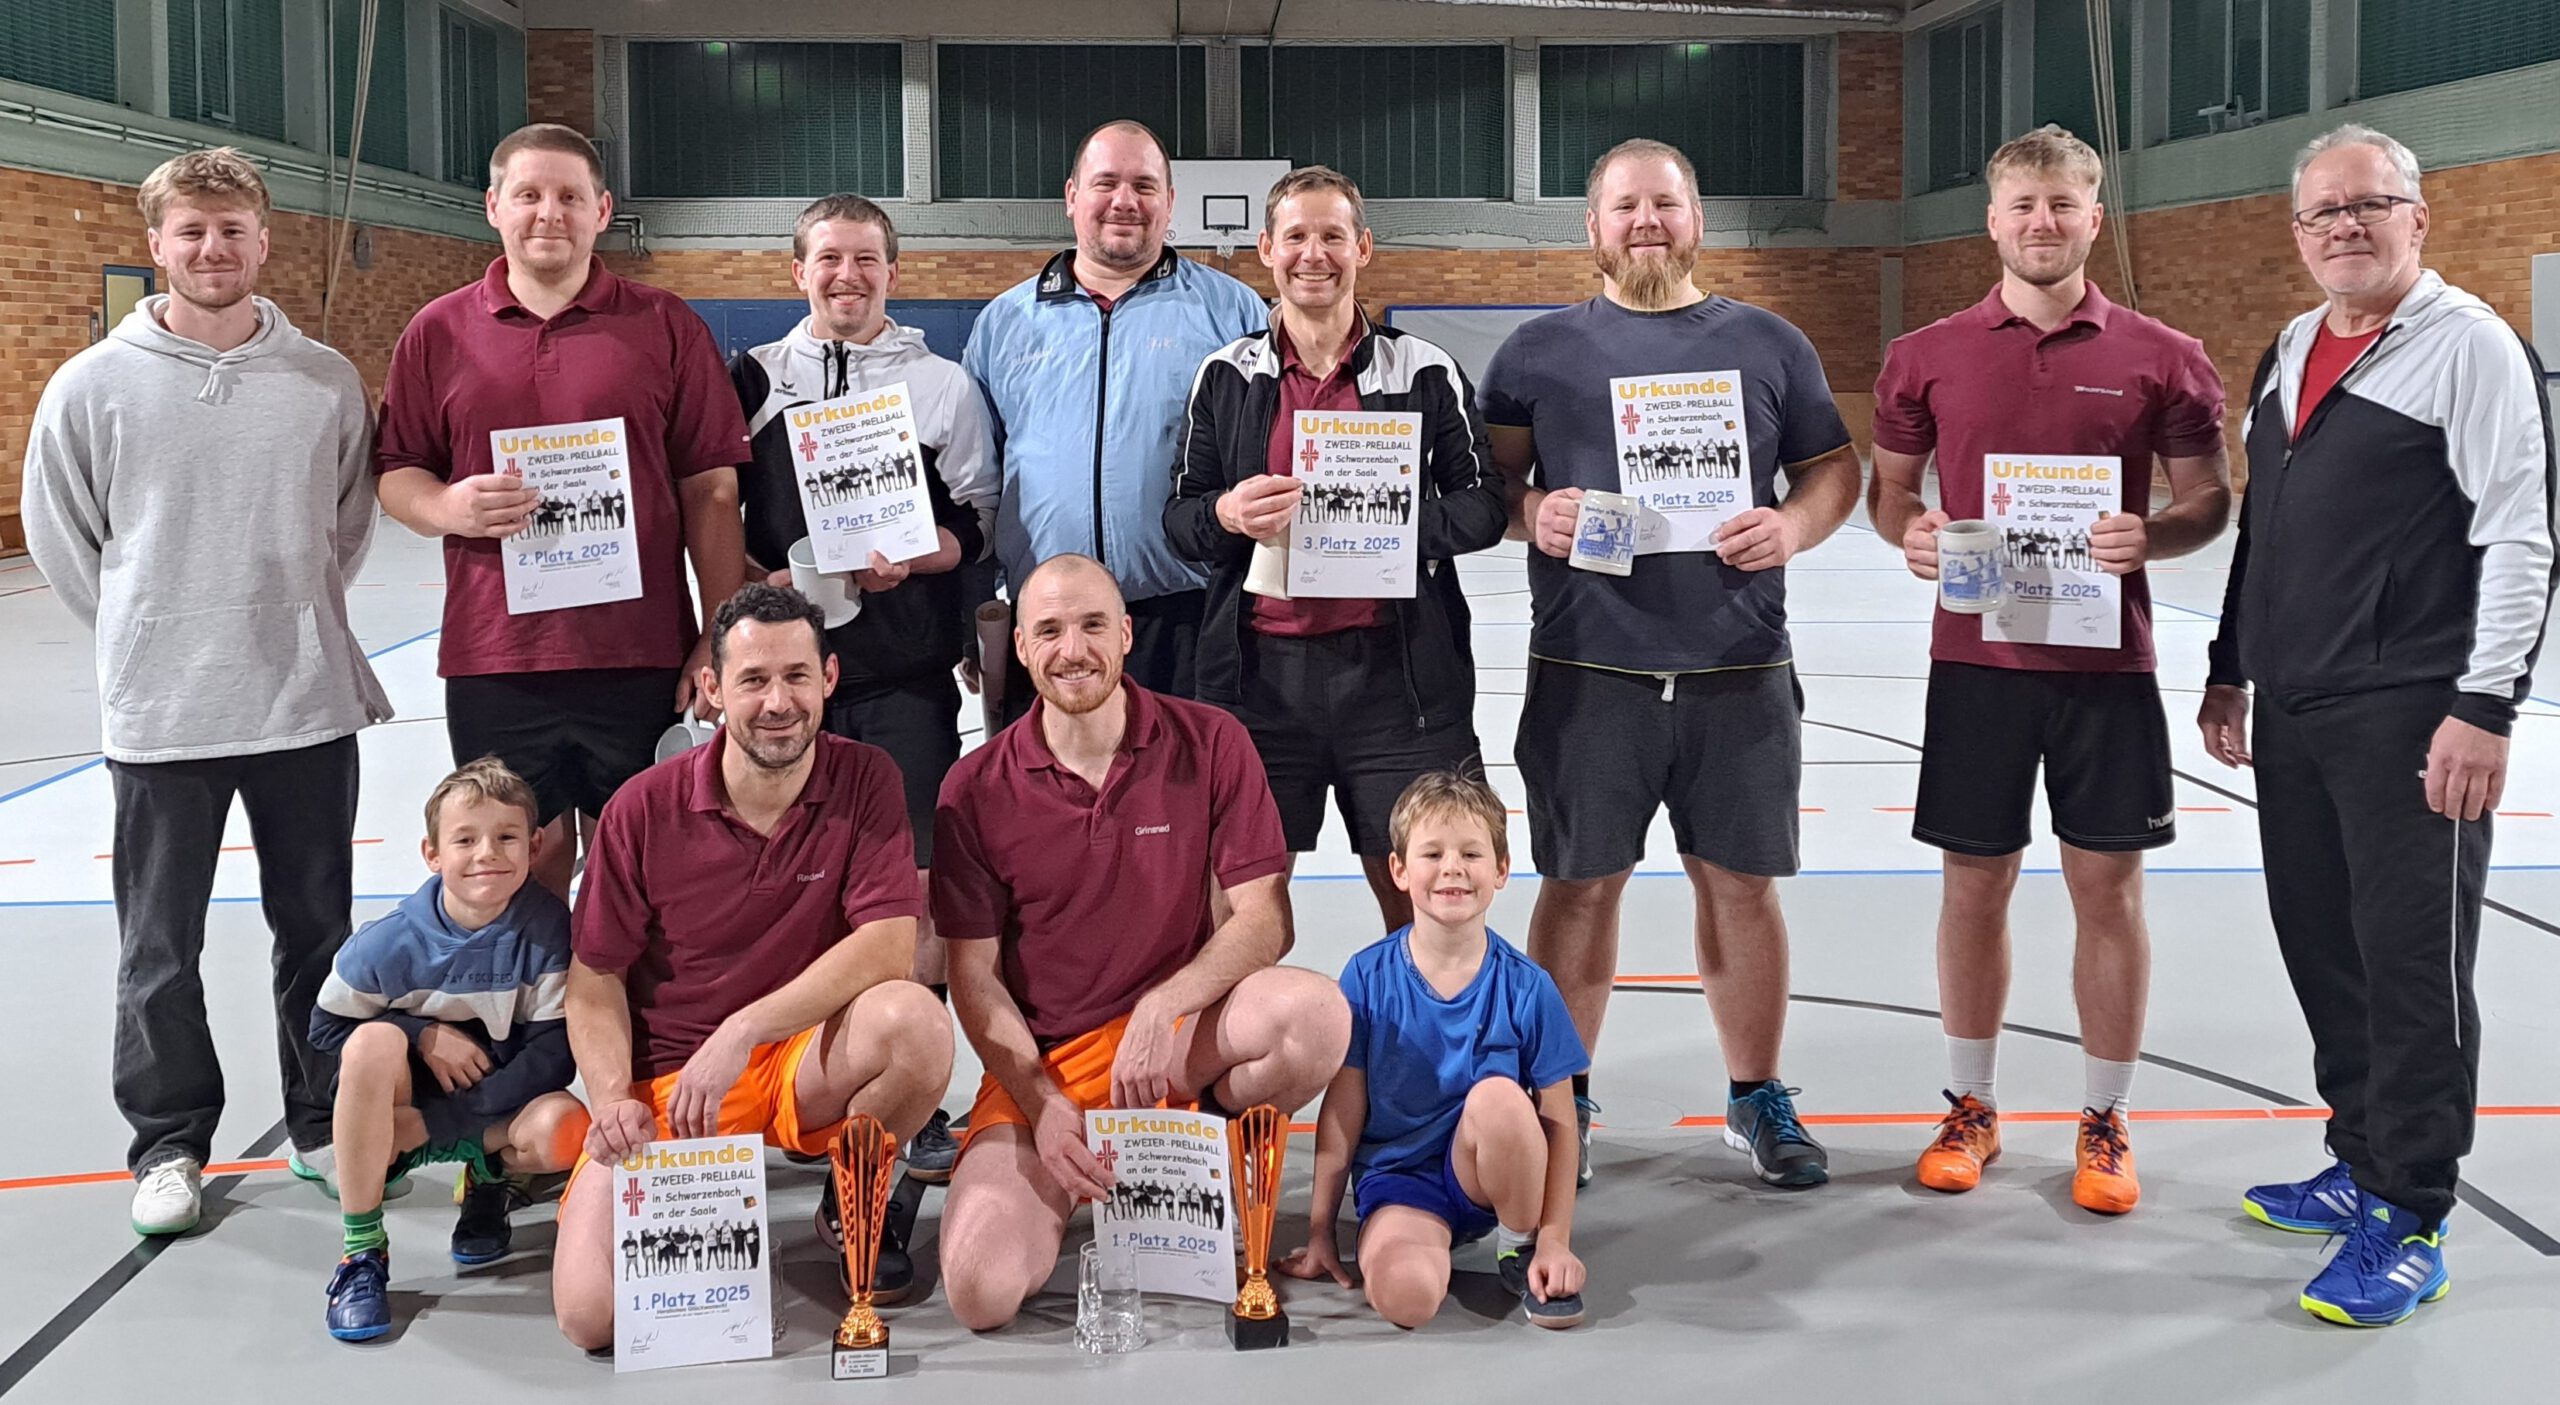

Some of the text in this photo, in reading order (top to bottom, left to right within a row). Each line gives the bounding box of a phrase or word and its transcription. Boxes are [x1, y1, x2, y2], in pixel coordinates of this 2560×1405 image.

[1618, 378, 1732, 399] Urkunde
[793, 393, 902, 428] Urkunde
[1301, 417, 1413, 435] Urkunde
[1647, 413, 1722, 424] in Schwarzenbach
[824, 427, 896, 449] in Schwarzenbach
[1661, 428, 1676, 436] der
[1680, 426, 1703, 435] Saale
[499, 428, 617, 454] Urkunde
[826, 444, 879, 462] an der Saale
[1325, 455, 1399, 463] in Schwarzenbach
[529, 463, 607, 479] in Schwarzenbach
[1337, 469, 1352, 477] der
[1355, 469, 1378, 477] Saale
[1992, 461, 2112, 480] Urkunde
[544, 480, 559, 491] der
[563, 479, 587, 489] Saale
[1698, 491, 1735, 503] 2025
[2018, 499, 2097, 509] in Schwarzenbach
[880, 500, 915, 519] 2025
[2050, 514, 2074, 522] Saale
[581, 542, 620, 558] 2025
[1364, 537, 1400, 550] 2025
[2062, 584, 2102, 598] 2025
[1095, 1116, 1219, 1140] Urkunde
[623, 1144, 754, 1171] Urkunde
[1125, 1153, 1207, 1166] in Schwarzenbach
[1142, 1166, 1157, 1174] der
[1162, 1168, 1186, 1176] Saale
[652, 1187, 741, 1202] in Schwarzenbach
[652, 1206, 717, 1220] an der Saale
[1178, 1235, 1216, 1254] 2025
[705, 1285, 750, 1302] 2025
